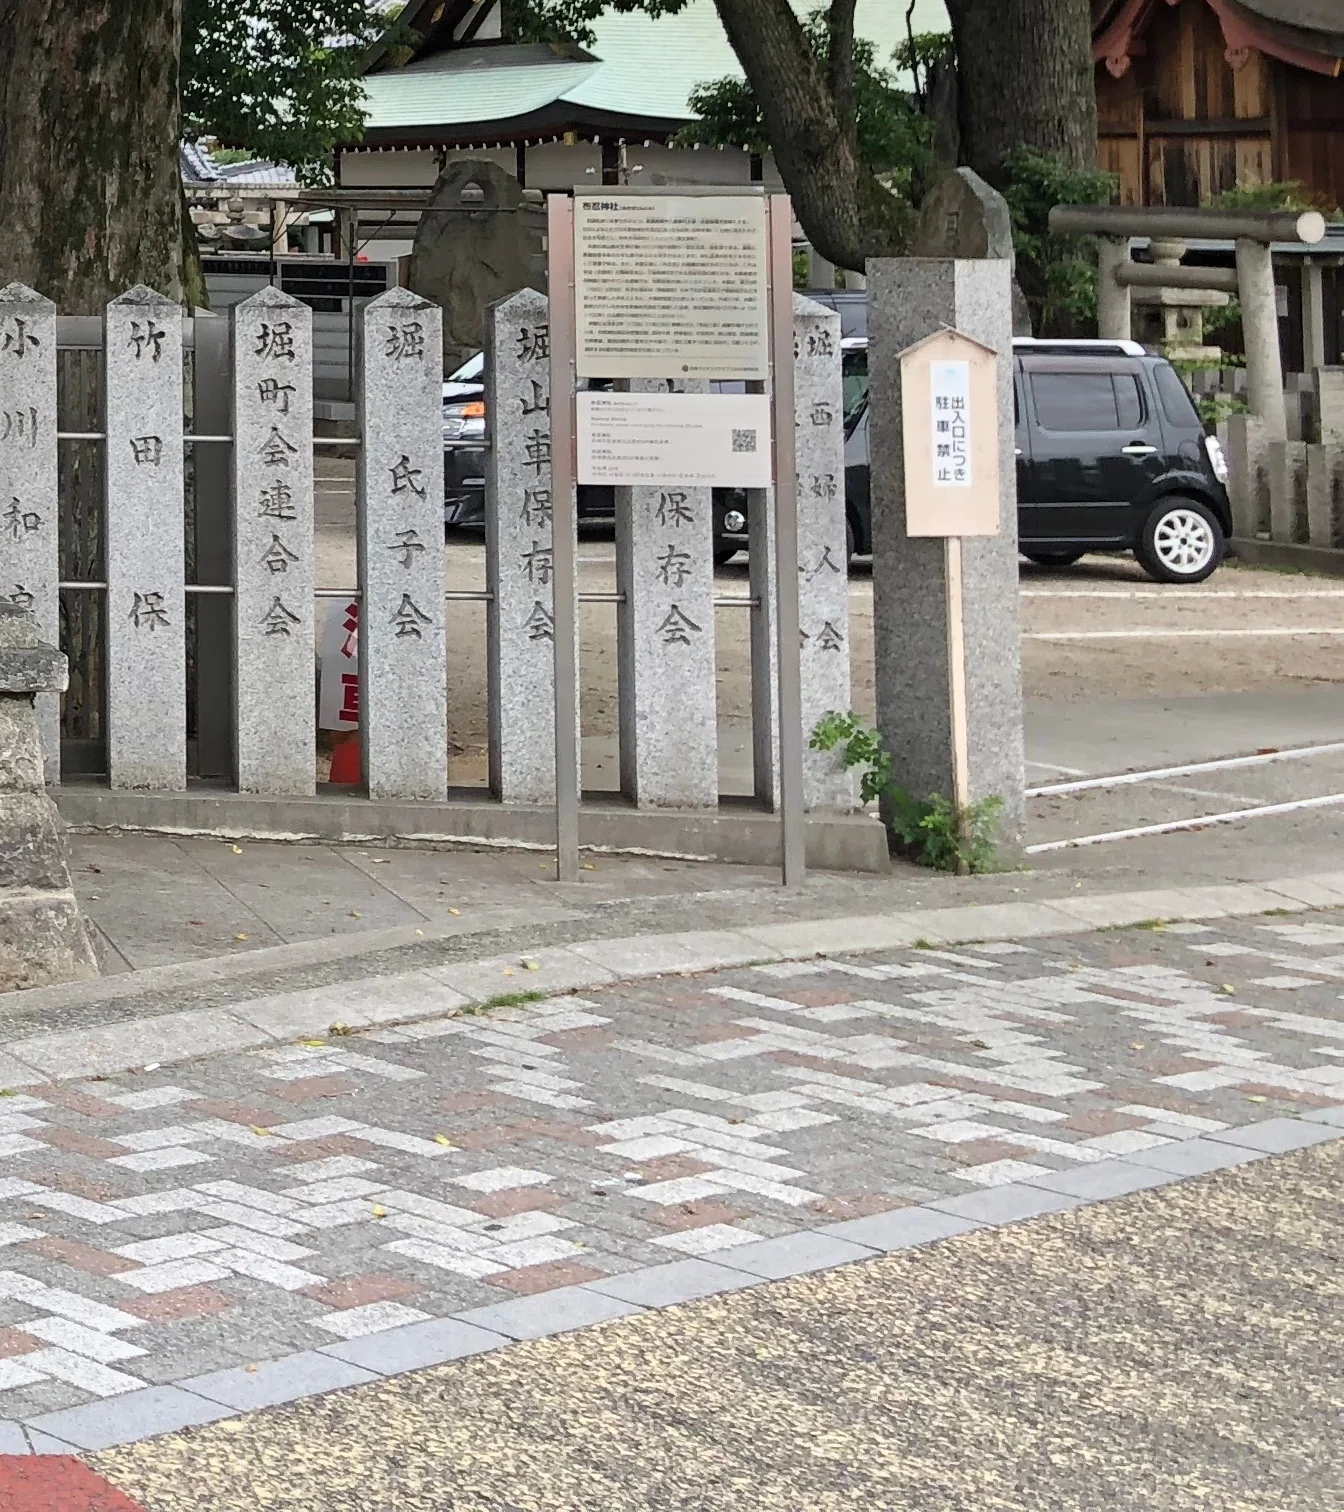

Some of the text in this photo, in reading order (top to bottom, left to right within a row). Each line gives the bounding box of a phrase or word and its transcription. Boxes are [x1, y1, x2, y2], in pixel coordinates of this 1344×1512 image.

[126, 319, 173, 630] 竹田保
[254, 321, 302, 638] 堀町会連合会
[384, 321, 434, 641] 堀氏子会
[805, 325, 845, 654] 堀西婦人会
[935, 395, 951, 482] 駐車禁止
[951, 395, 967, 482] 出入口につき
